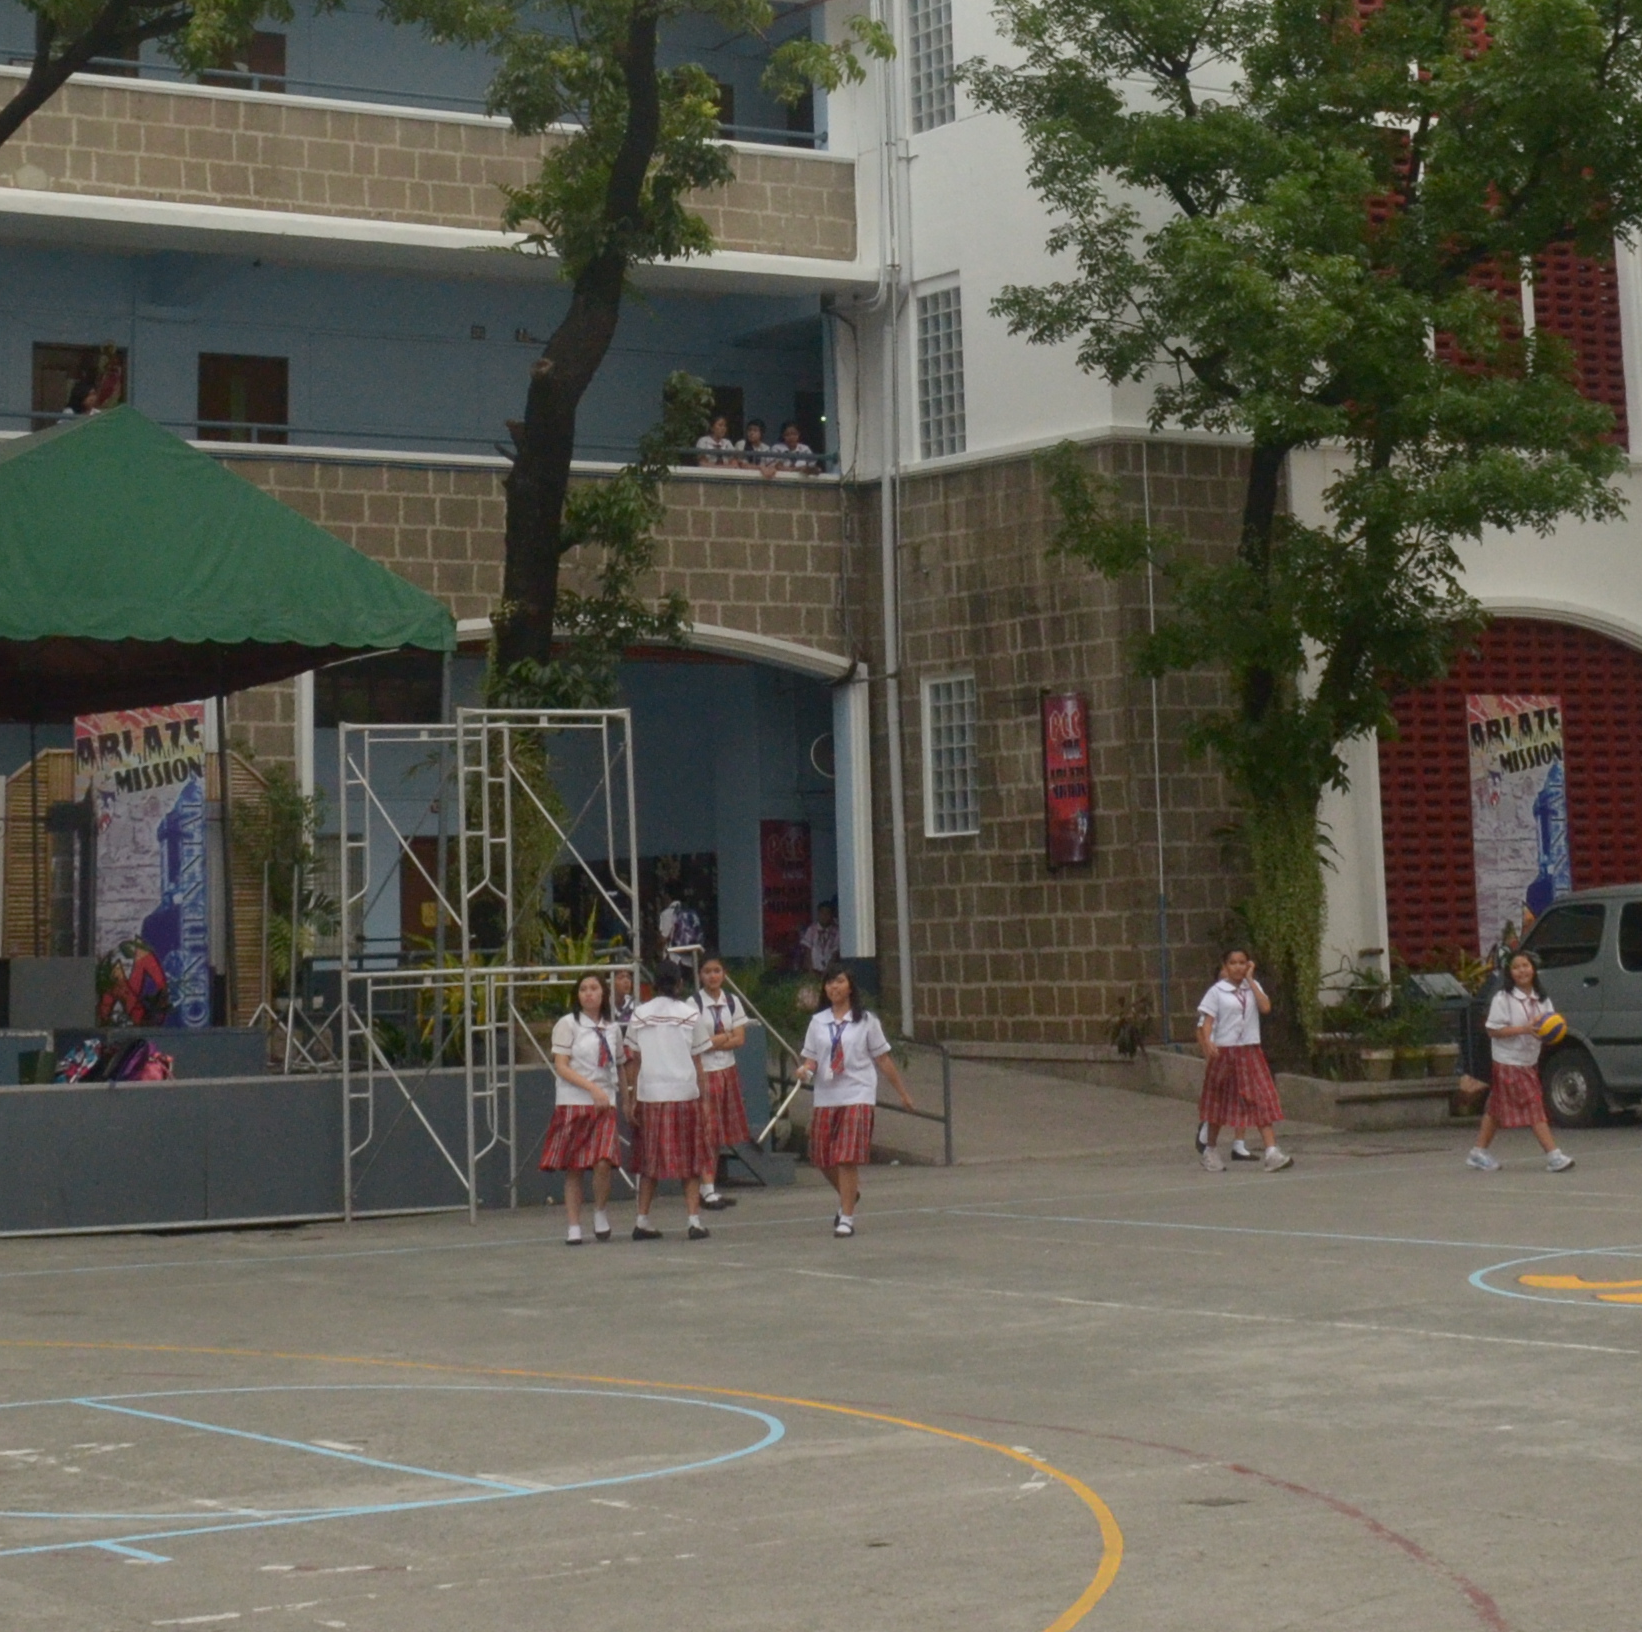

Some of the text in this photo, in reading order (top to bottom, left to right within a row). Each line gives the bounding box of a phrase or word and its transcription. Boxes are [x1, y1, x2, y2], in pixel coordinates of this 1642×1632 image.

[114, 756, 205, 795] MISSION
[1499, 741, 1563, 775] MISSION
[181, 792, 208, 1027] CENTENNIAL
